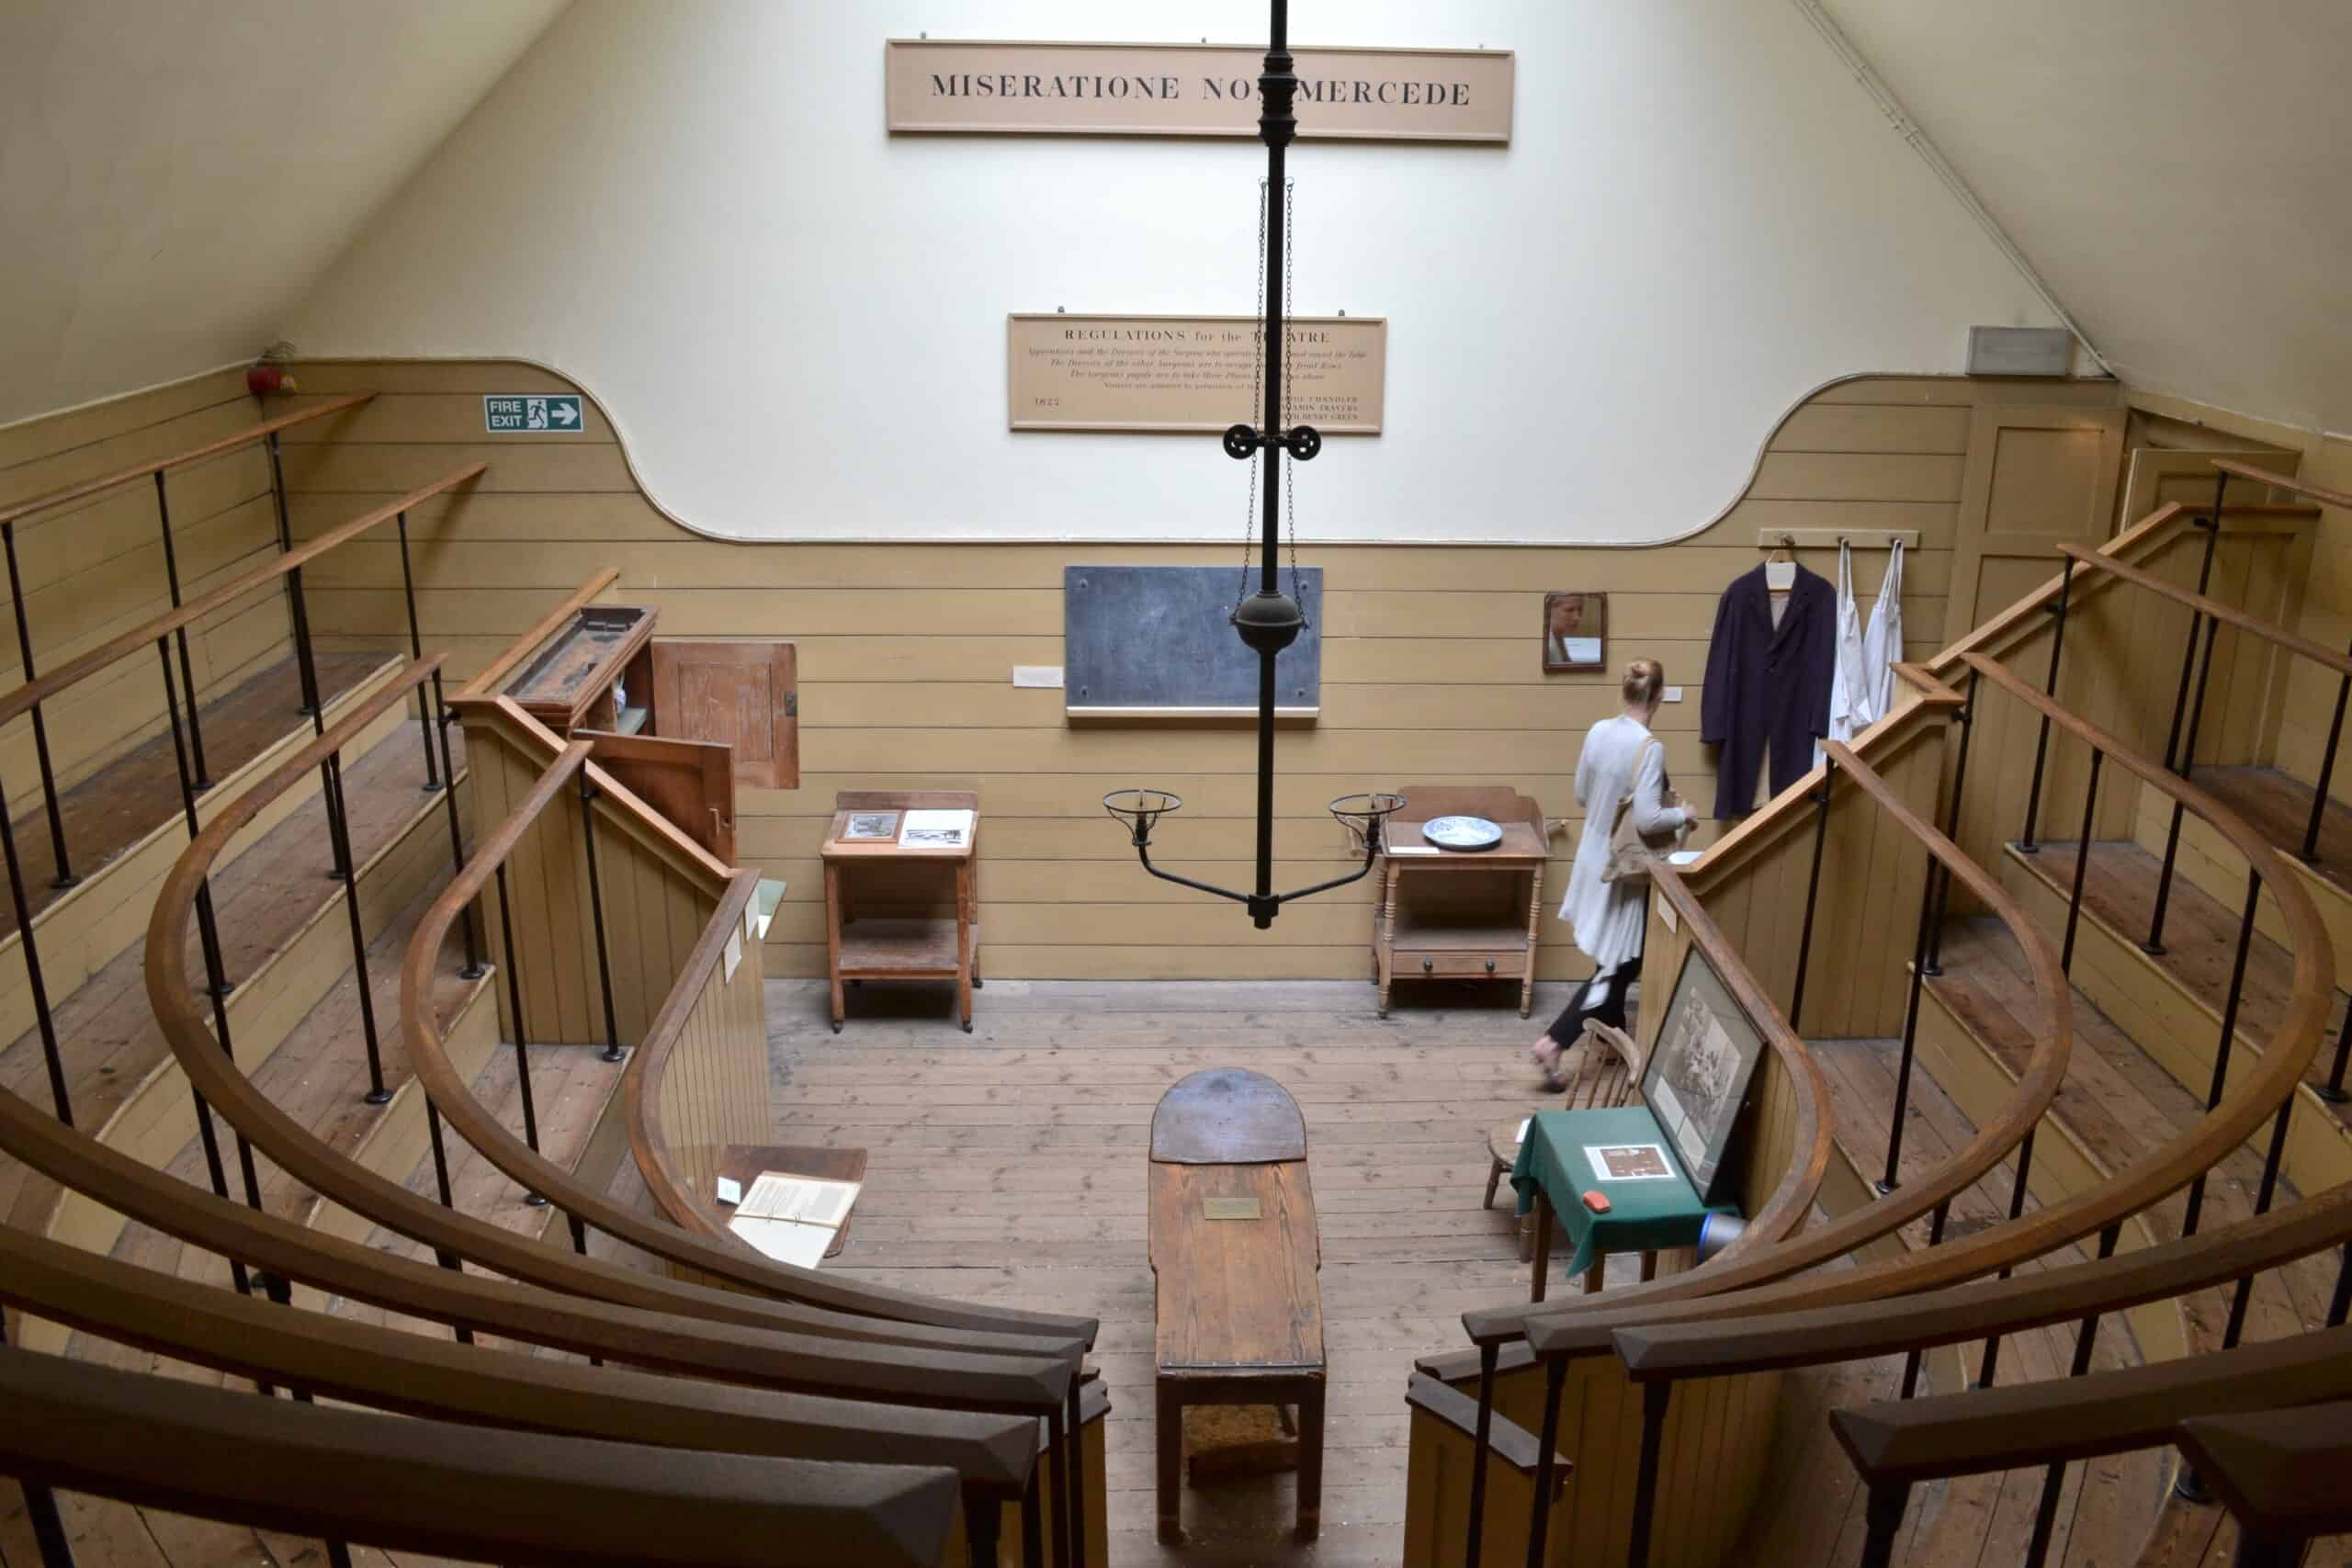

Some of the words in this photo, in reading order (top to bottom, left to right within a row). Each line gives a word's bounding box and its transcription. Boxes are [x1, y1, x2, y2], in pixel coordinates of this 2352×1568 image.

[930, 73, 1181, 100] MISERATIONE
[1203, 77, 1261, 100] NO
[1298, 80, 1470, 106] MERCEDE
[1065, 330, 1185, 341] REGULATIONS
[1195, 331, 1213, 343] for
[1221, 332, 1242, 343] the
[1250, 331, 1330, 344] TATRE
[490, 400, 522, 412] FIRE
[492, 415, 522, 426] EXIT
